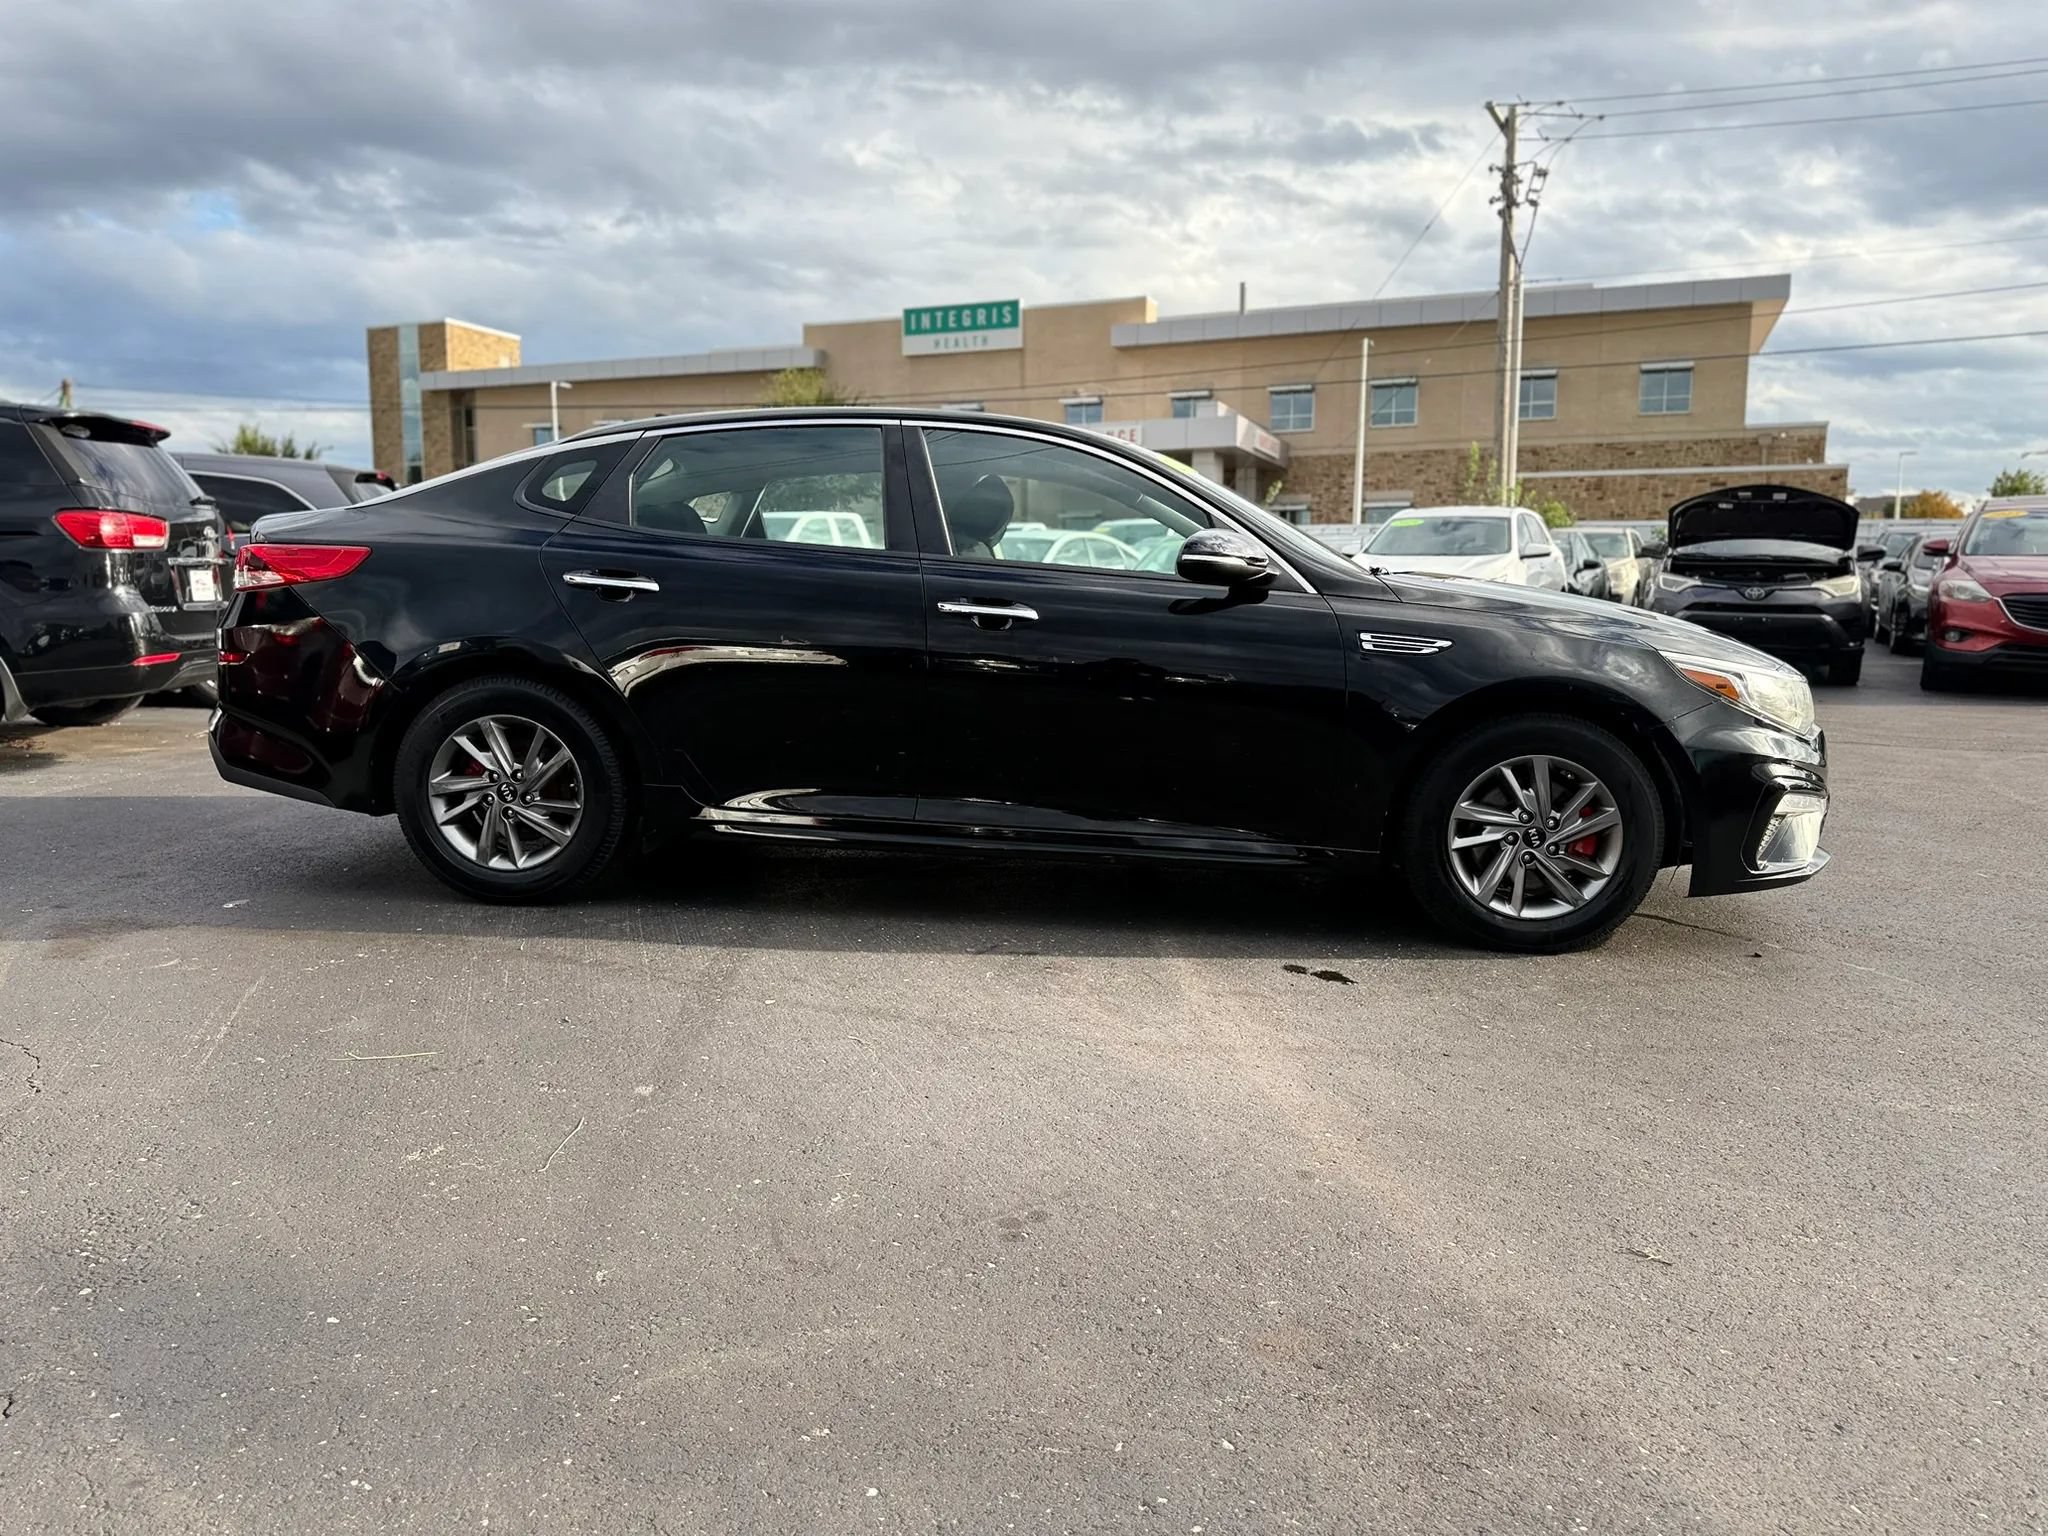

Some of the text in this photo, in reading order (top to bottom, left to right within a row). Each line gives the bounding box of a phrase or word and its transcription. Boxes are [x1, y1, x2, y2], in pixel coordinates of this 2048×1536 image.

[910, 305, 1013, 330] INTEGRIS
[933, 335, 988, 349] HEALTH
[501, 783, 514, 801] KIA
[1528, 828, 1540, 847] KIA
